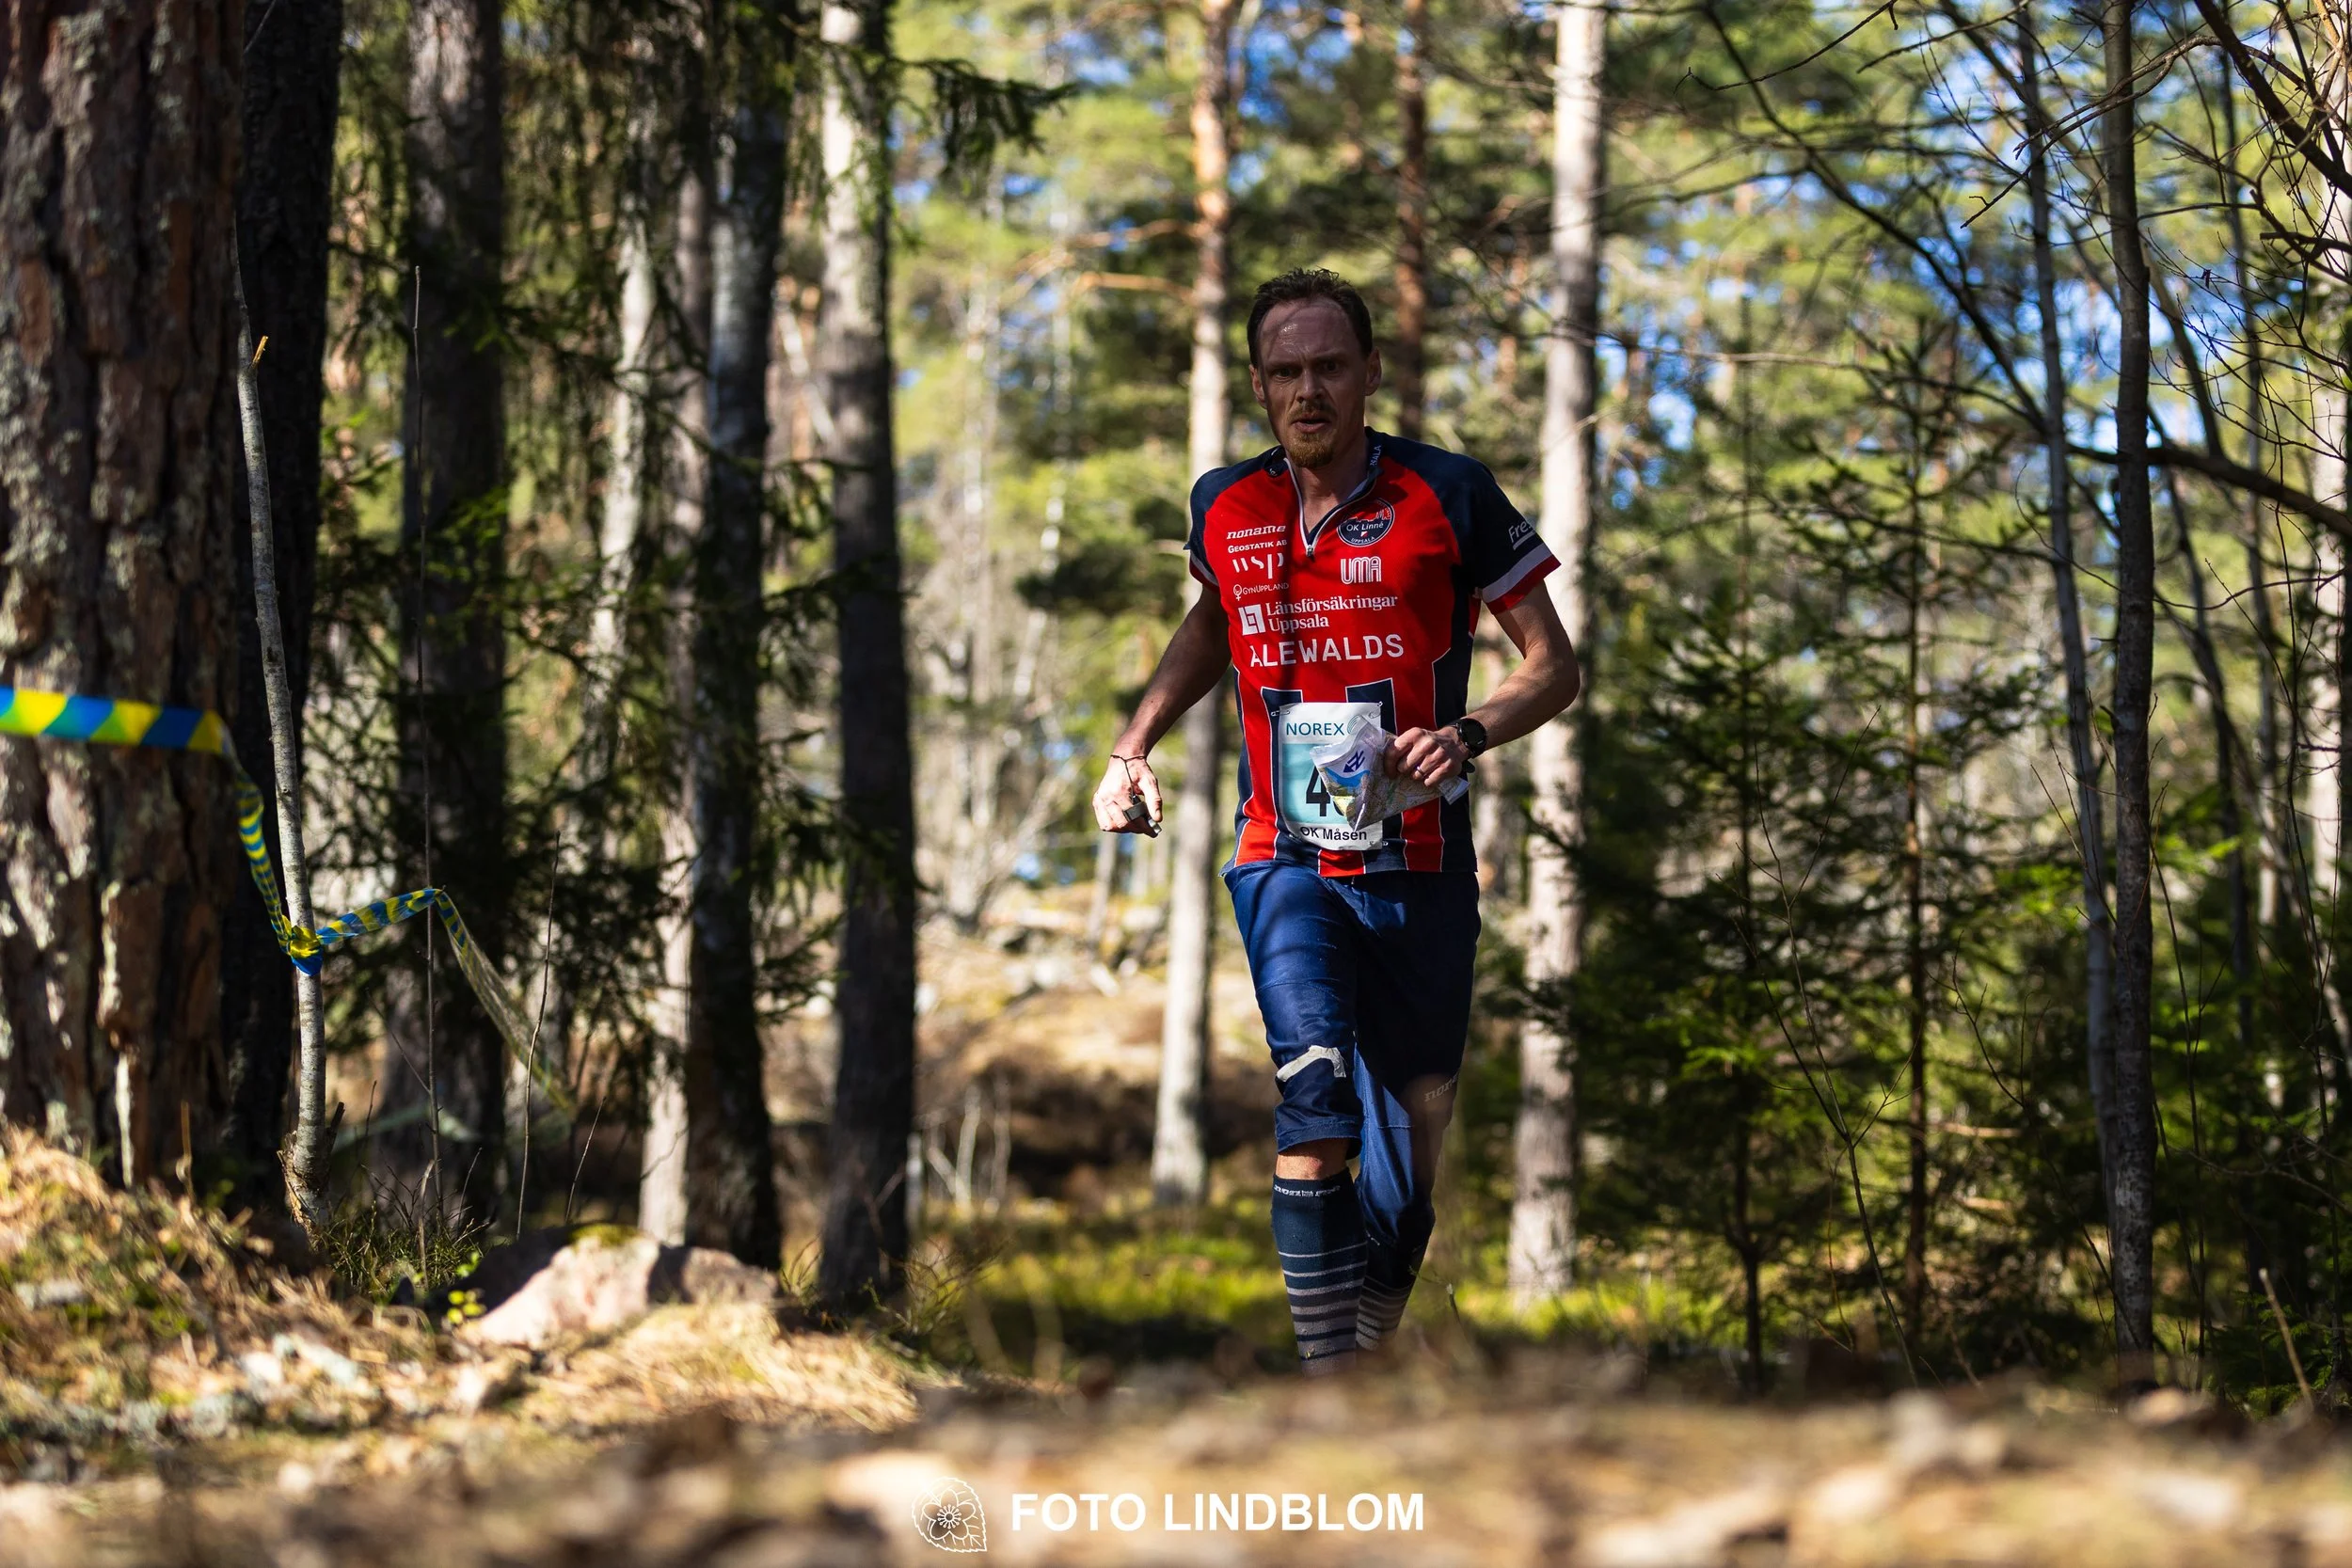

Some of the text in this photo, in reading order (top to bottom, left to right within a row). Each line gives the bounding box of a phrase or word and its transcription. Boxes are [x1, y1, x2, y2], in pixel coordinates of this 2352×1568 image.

[1226, 525, 1286, 540] noname
[1361, 521, 1384, 531] Linné
[1508, 520, 1532, 543] Fre
[1228, 541, 1274, 553] GEOSTATIK
[1340, 556, 1382, 585] UMA
[1265, 594, 1399, 616] Länsförsäkringar
[1267, 613, 1330, 634] Uppsala
[1249, 633, 1405, 668] ALEWALDS
[1286, 722, 1345, 736] NOREX
[1306, 765, 1344, 817] 4
[1300, 826, 1368, 841] OK Måsen
